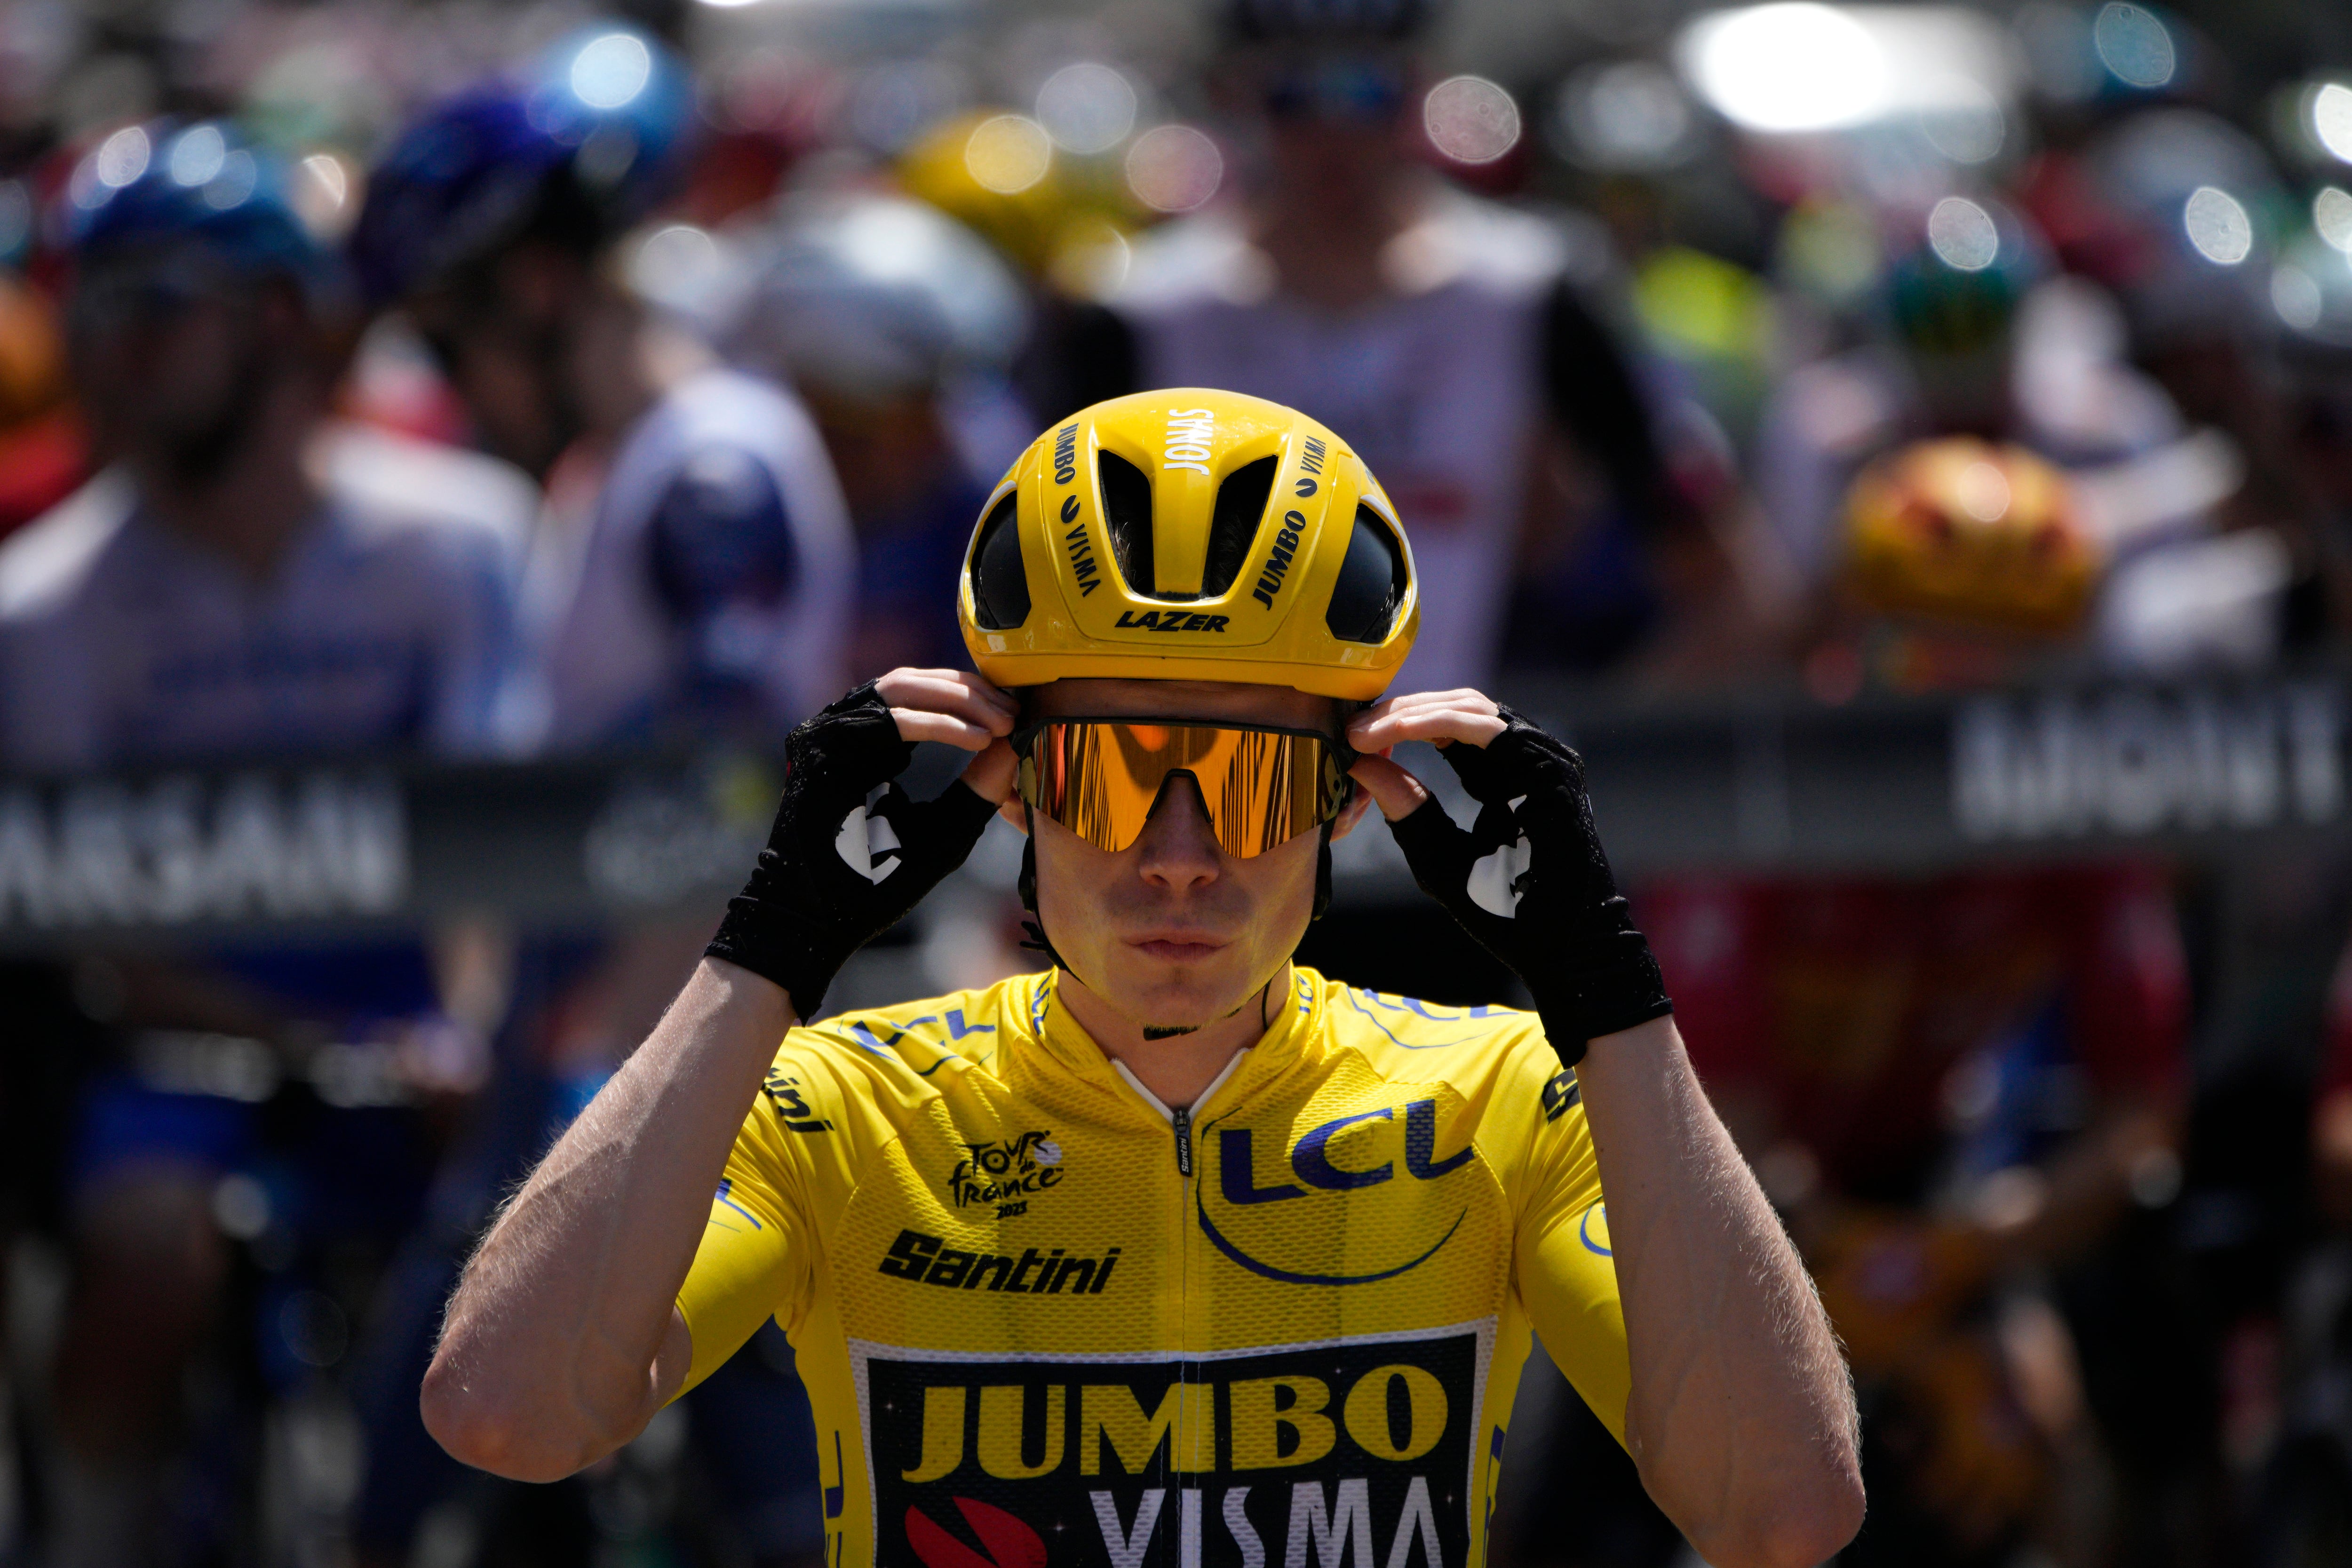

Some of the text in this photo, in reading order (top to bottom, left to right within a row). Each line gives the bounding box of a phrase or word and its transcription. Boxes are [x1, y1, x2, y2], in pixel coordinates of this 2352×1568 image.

[1164, 409, 1215, 476] JONAS
[1054, 422, 1101, 598] JUMBO VISMA
[1253, 435, 1326, 611] JUMBO VISMA
[1114, 611, 1230, 632] LAZER
[1181, 1136, 1189, 1173] Santini
[1221, 1098, 1474, 1204] LCL
[996, 1201, 1028, 1219] 2023
[878, 1229, 1121, 1294] Santini
[901, 1363, 1449, 1484] JUMBO
[1088, 1476, 1443, 1568] VISMA
